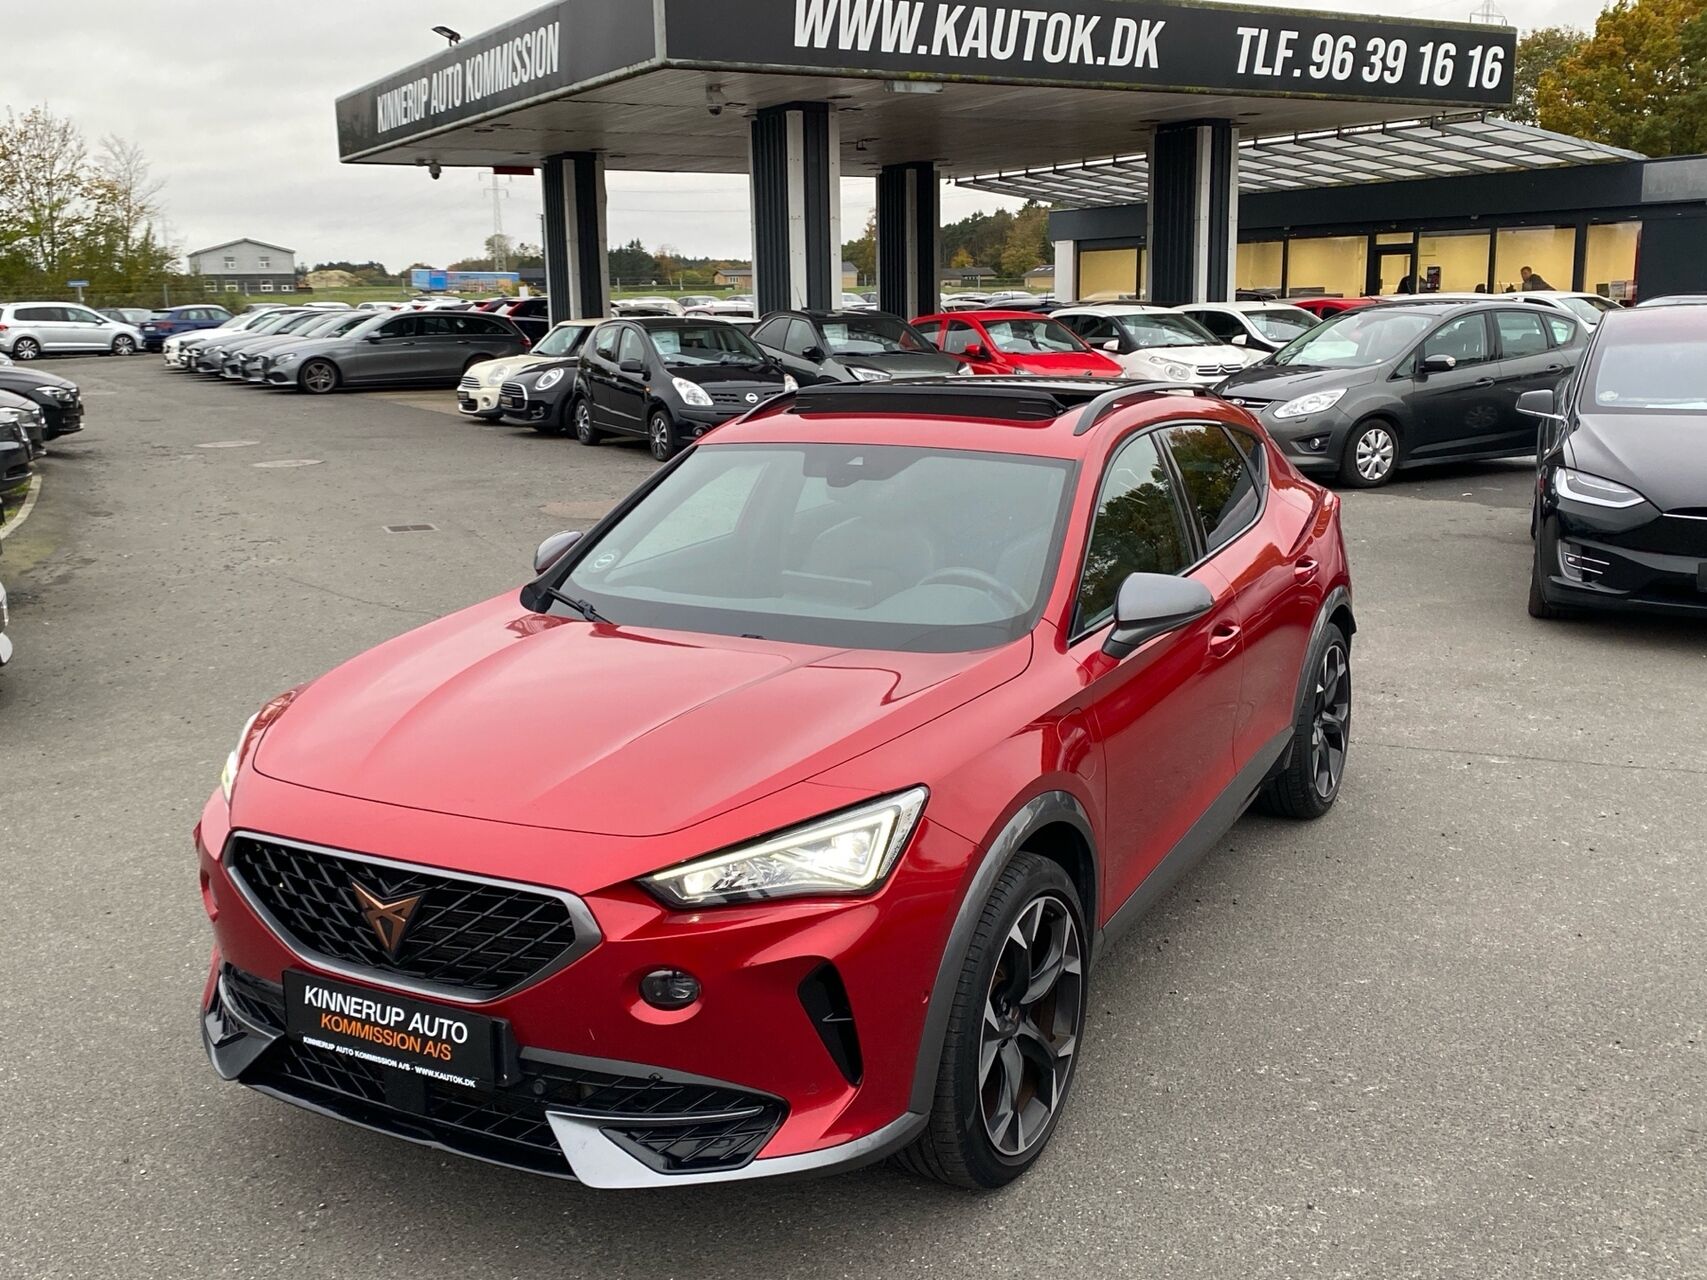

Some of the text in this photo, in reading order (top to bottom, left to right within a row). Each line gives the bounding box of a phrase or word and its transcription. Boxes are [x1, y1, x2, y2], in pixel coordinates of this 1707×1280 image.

[793, 0, 1166, 69] WWW.KAUTOK.DK
[1236, 27, 1505, 89] TLF. 96 39 16 16
[377, 22, 560, 133] KINNERUP AUTO KOMMISSION
[304, 985, 468, 1043] KINNERUP AUTO
[321, 1013, 452, 1061] KOMMISSION A/S
[303, 1036, 335, 1051] KINNERUP
[335, 1045, 354, 1056] AUTO
[354, 1051, 397, 1068] KOMMISSION
[398, 1062, 411, 1071] A/S
[415, 1066, 476, 1088] WWW.KAUTOK.DK
